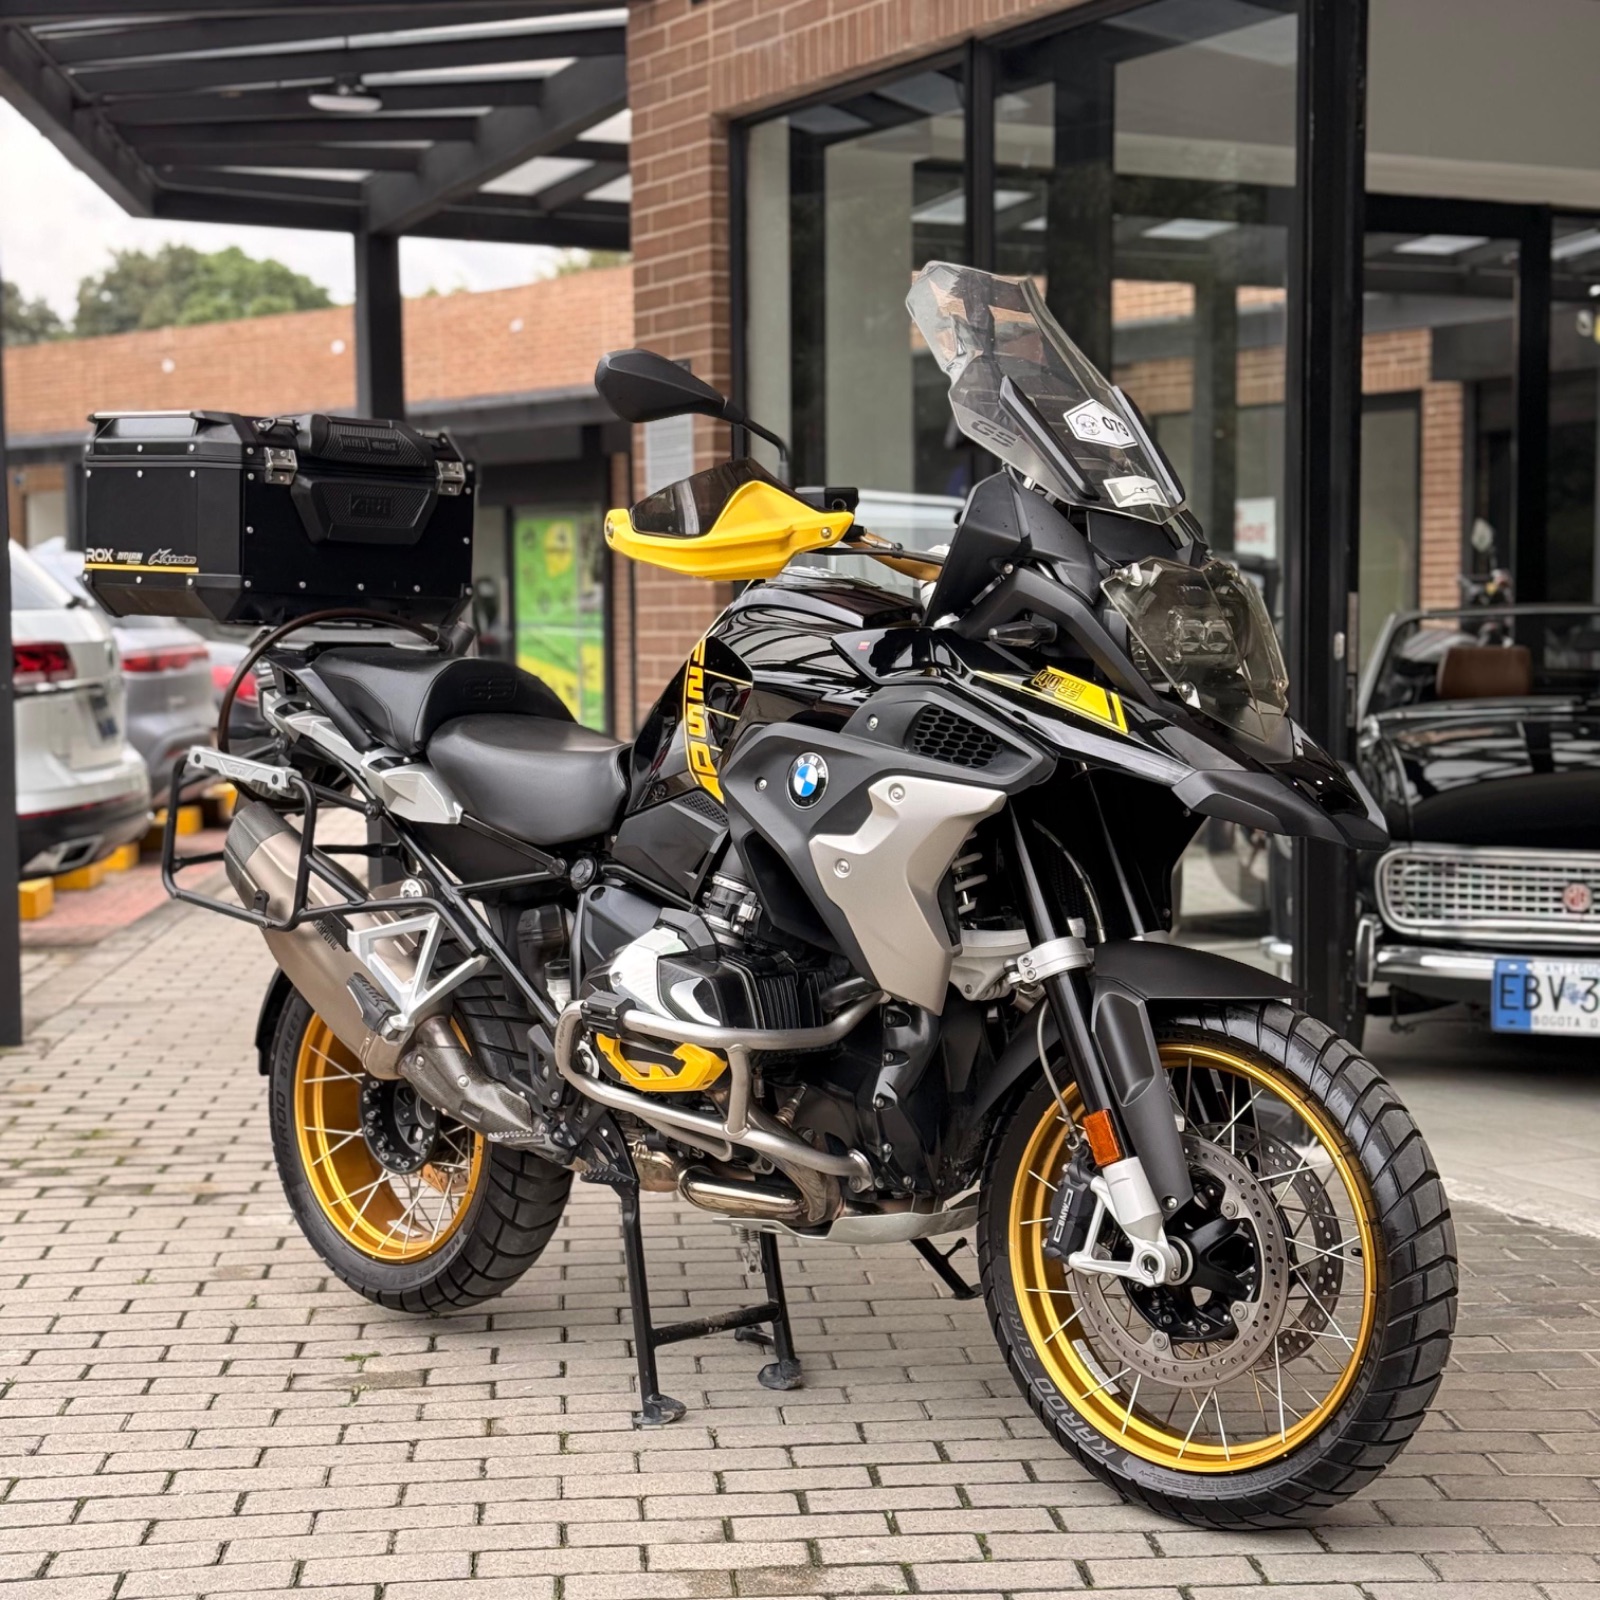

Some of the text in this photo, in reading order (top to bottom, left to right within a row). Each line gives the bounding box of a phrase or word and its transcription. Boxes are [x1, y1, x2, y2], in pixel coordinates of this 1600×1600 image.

[971, 420, 1017, 448] GS
[1101, 416, 1130, 437] 079
[86, 548, 113, 562] ROX
[1036, 672, 1062, 691] 40
[1057, 685, 1078, 699] GS
[1034, 1377, 1117, 1456] KAROO
